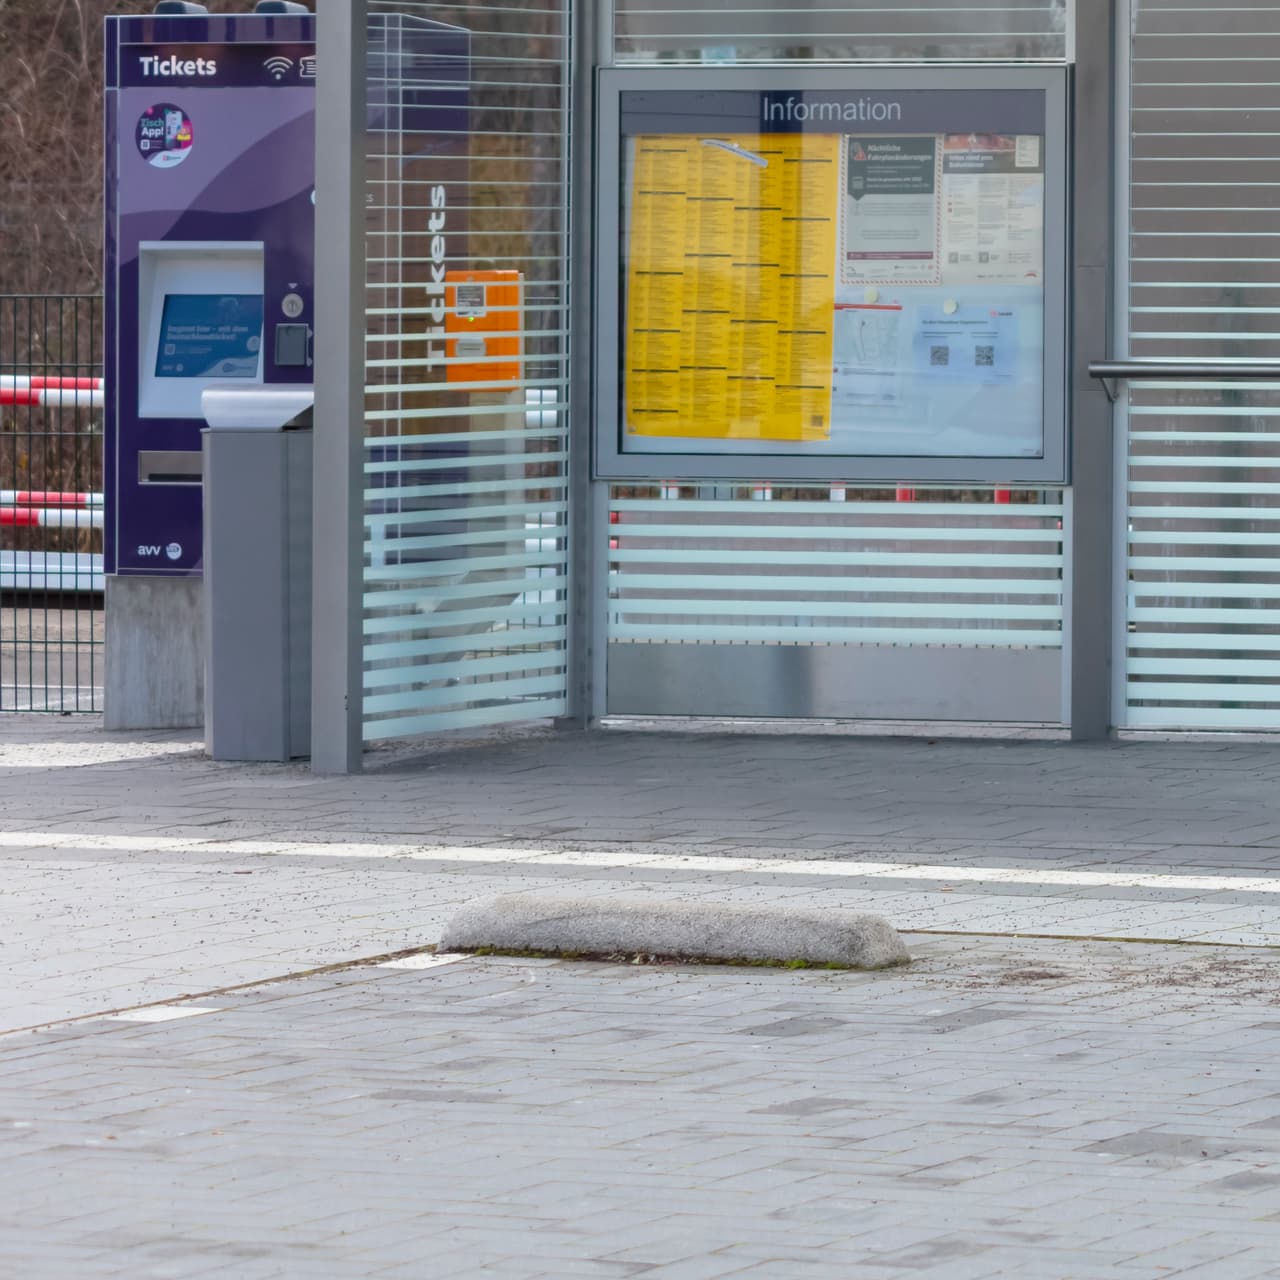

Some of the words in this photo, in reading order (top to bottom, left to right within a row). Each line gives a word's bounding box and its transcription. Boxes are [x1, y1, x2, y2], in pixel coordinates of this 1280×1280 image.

[138, 54, 217, 76] Tickets
[763, 96, 902, 121] Information
[141, 126, 165, 139] App!
[425, 184, 446, 373] Tickets
